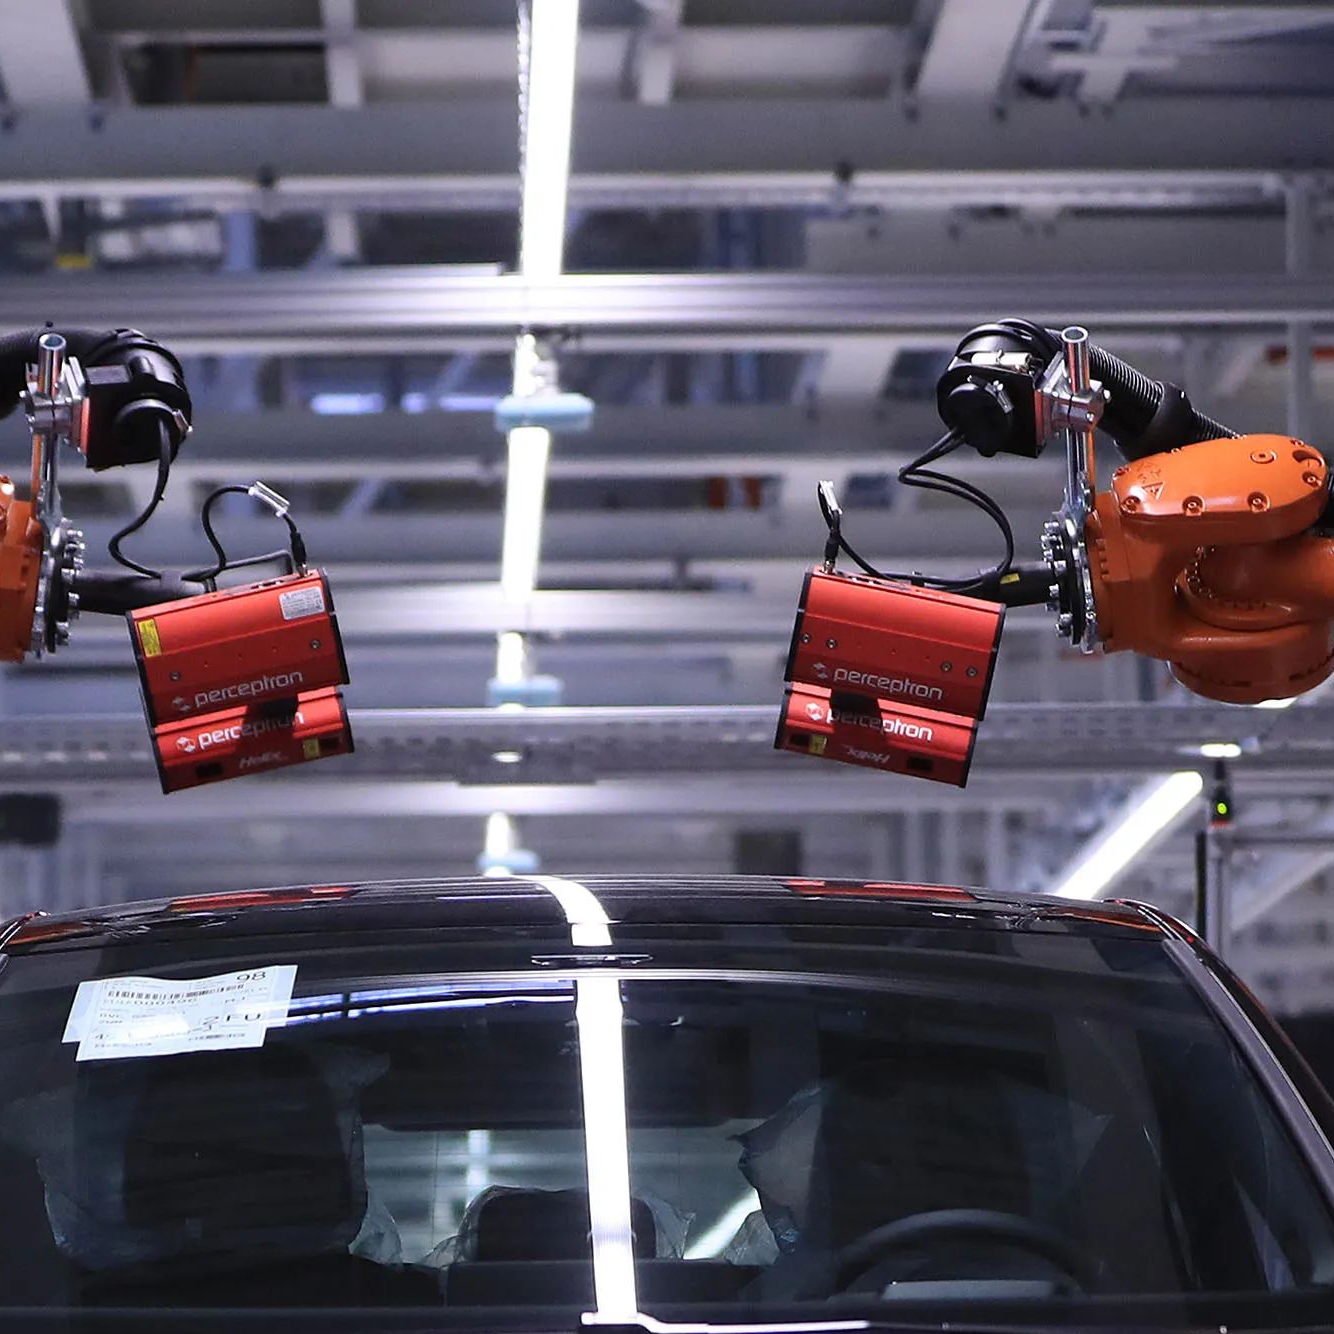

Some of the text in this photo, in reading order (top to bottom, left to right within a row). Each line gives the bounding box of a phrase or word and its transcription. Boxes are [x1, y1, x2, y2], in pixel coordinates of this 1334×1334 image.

[194, 671, 304, 709] perceptron
[833, 667, 944, 701] perceptron
[198, 711, 306, 751] perceptron
[826, 708, 934, 742] perceptron
[236, 970, 268, 983] 98
